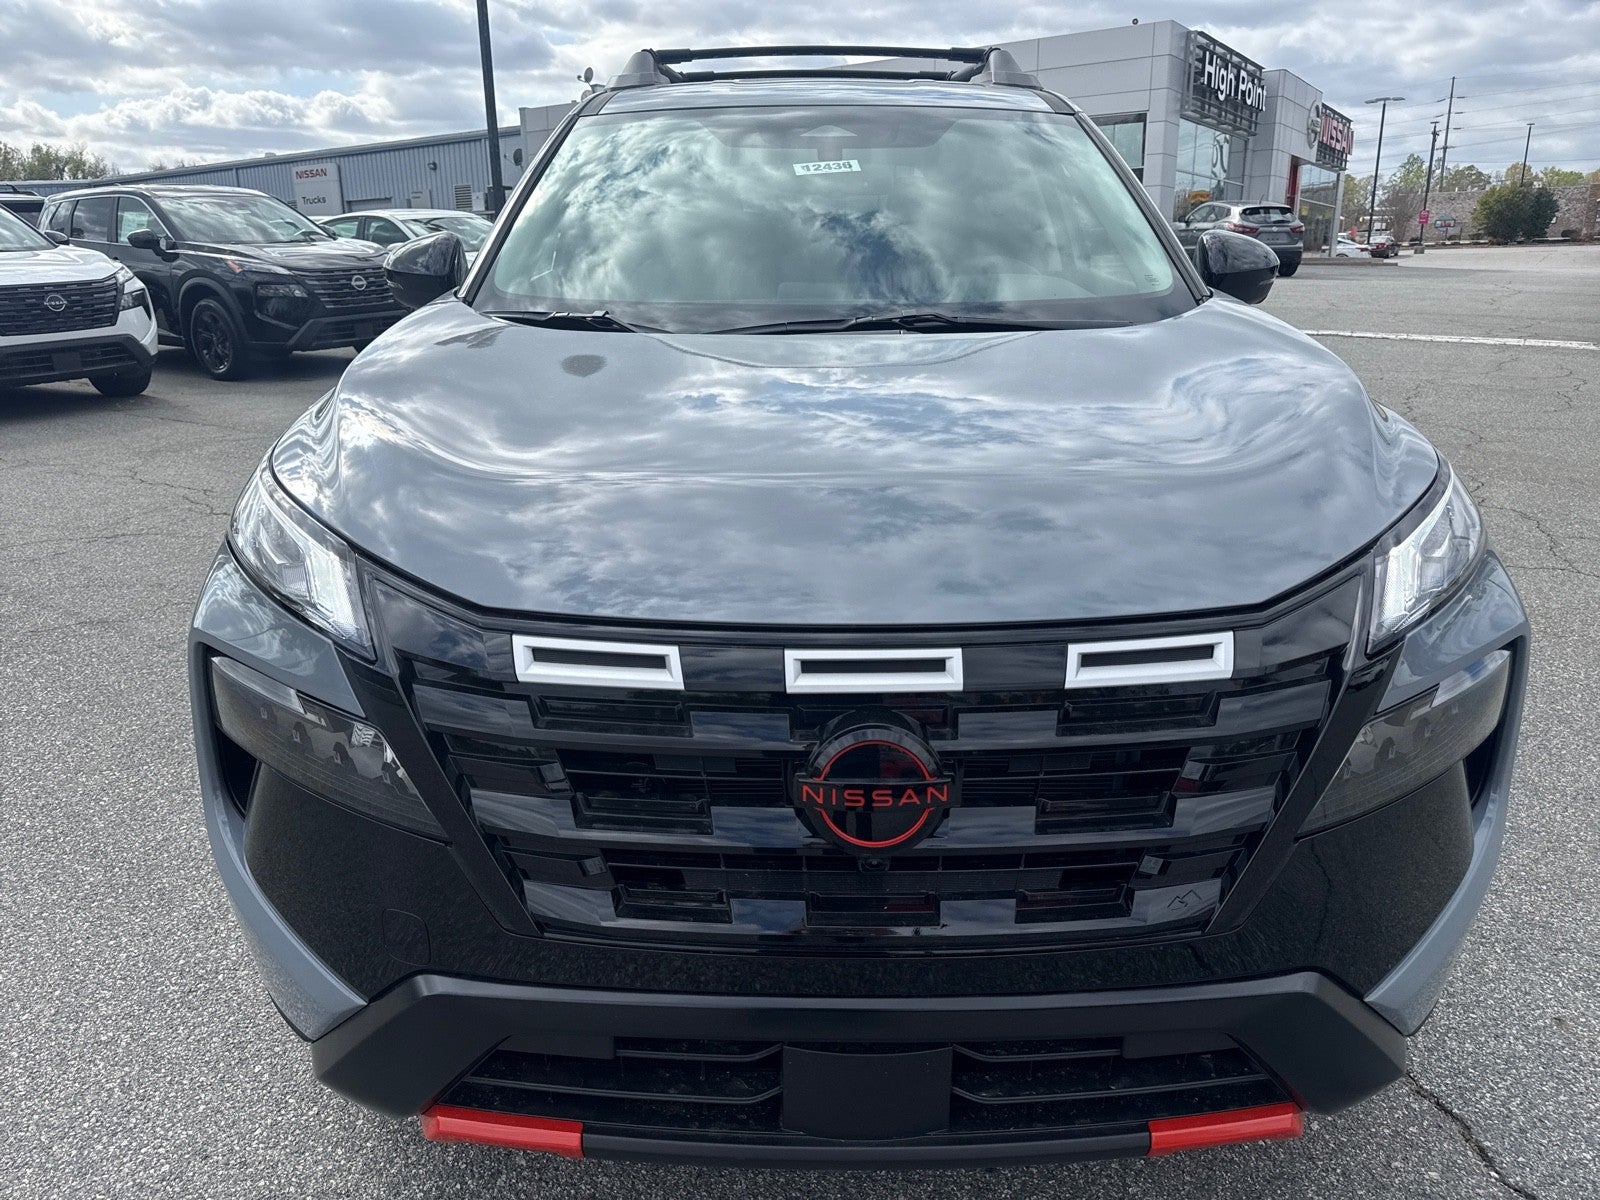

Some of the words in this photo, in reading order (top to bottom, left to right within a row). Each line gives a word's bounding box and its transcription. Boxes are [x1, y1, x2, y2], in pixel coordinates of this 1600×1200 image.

[1204, 51, 1235, 101] High
[1238, 69, 1267, 111] Point
[1320, 113, 1354, 155] NISSAN
[296, 168, 327, 179] NISSAN
[301, 196, 326, 205] Trucks
[802, 784, 949, 807] NISSAN
